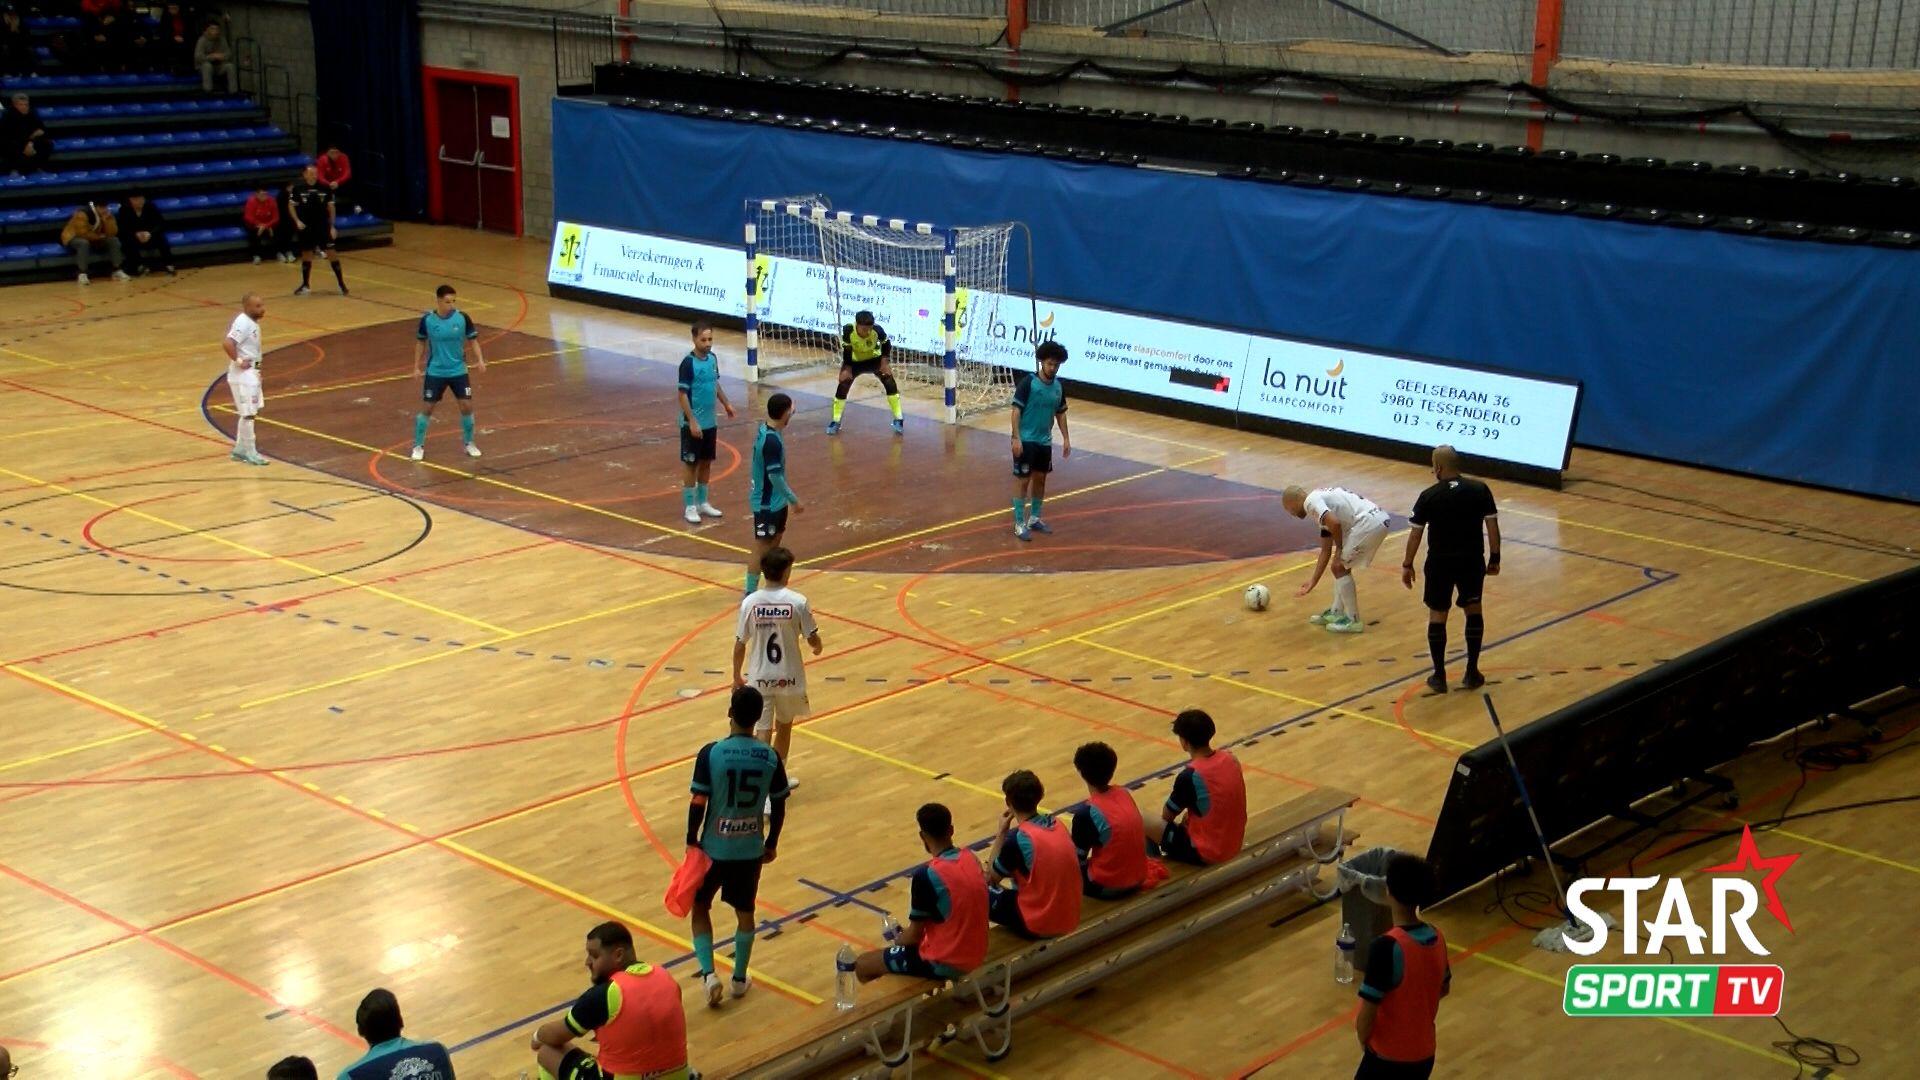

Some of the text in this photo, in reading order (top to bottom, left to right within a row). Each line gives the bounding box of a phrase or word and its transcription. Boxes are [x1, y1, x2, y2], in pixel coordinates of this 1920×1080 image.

[621, 245, 705, 272] Verzekeringen &
[647, 272, 727, 301] dienstverlening
[986, 311, 1006, 339] la
[1013, 324, 1057, 344] nuit
[984, 343, 1035, 358] SLAAPCOM
[1084, 350, 1096, 360] op
[1097, 351, 1119, 363] jouw
[1120, 356, 1142, 367] maat
[1087, 335, 1233, 369] Het betere slaapcomfort door ons
[1263, 357, 1348, 400] la nuit
[1260, 392, 1344, 415] SLAAPCOMFORT
[1395, 379, 1511, 408] GEELSEBAAN 36
[1380, 392, 1521, 426] 3980 TESSENDERLO
[1393, 412, 1420, 426] 013
[1436, 419, 1454, 432] 67
[1458, 423, 1477, 436] 23
[1482, 427, 1500, 440] 99
[757, 607, 790, 617] Hubo
[766, 632, 782, 665] 6
[756, 678, 796, 688] TYSON
[726, 769, 763, 808] 15
[720, 821, 757, 832] Hubo
